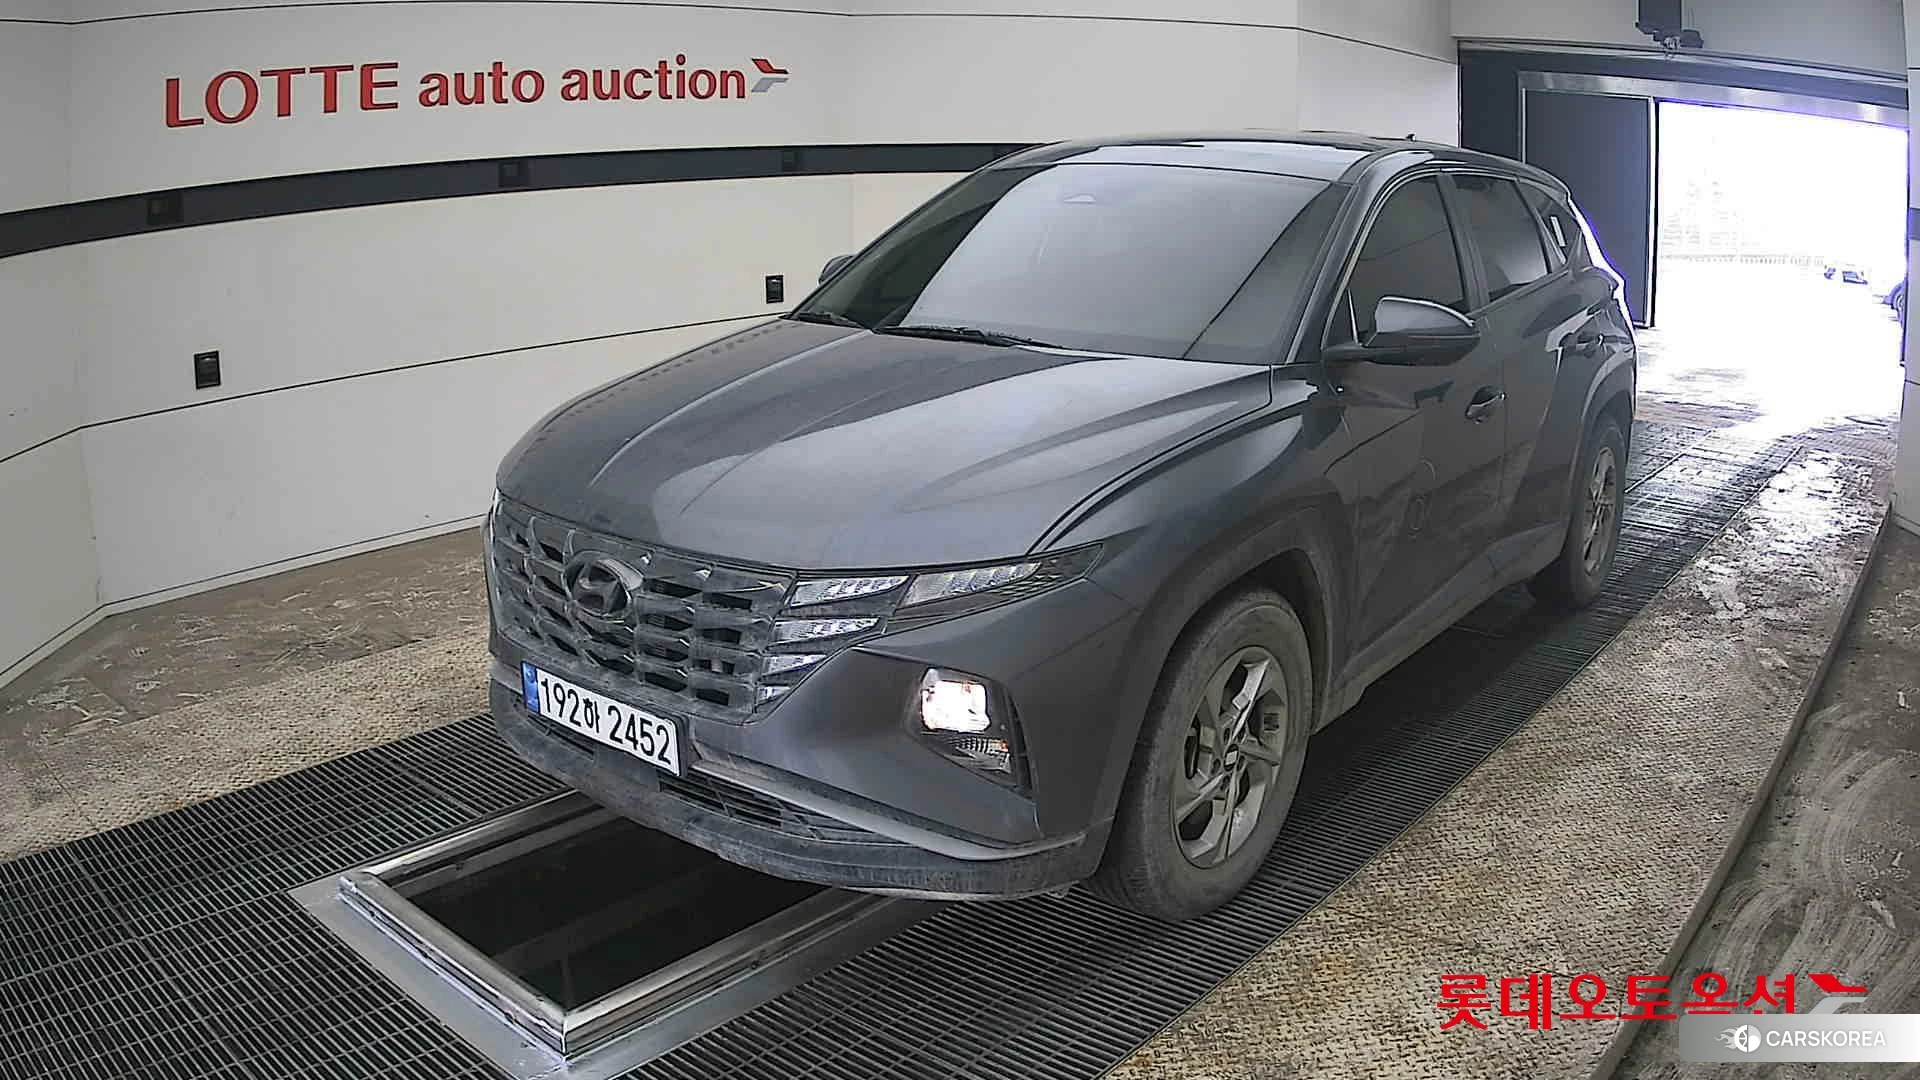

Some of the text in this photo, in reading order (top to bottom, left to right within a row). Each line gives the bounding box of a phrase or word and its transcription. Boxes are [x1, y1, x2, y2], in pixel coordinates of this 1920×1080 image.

[165, 54, 747, 128] LOTTE auto auction
[541, 678, 671, 764] 192하 2452
